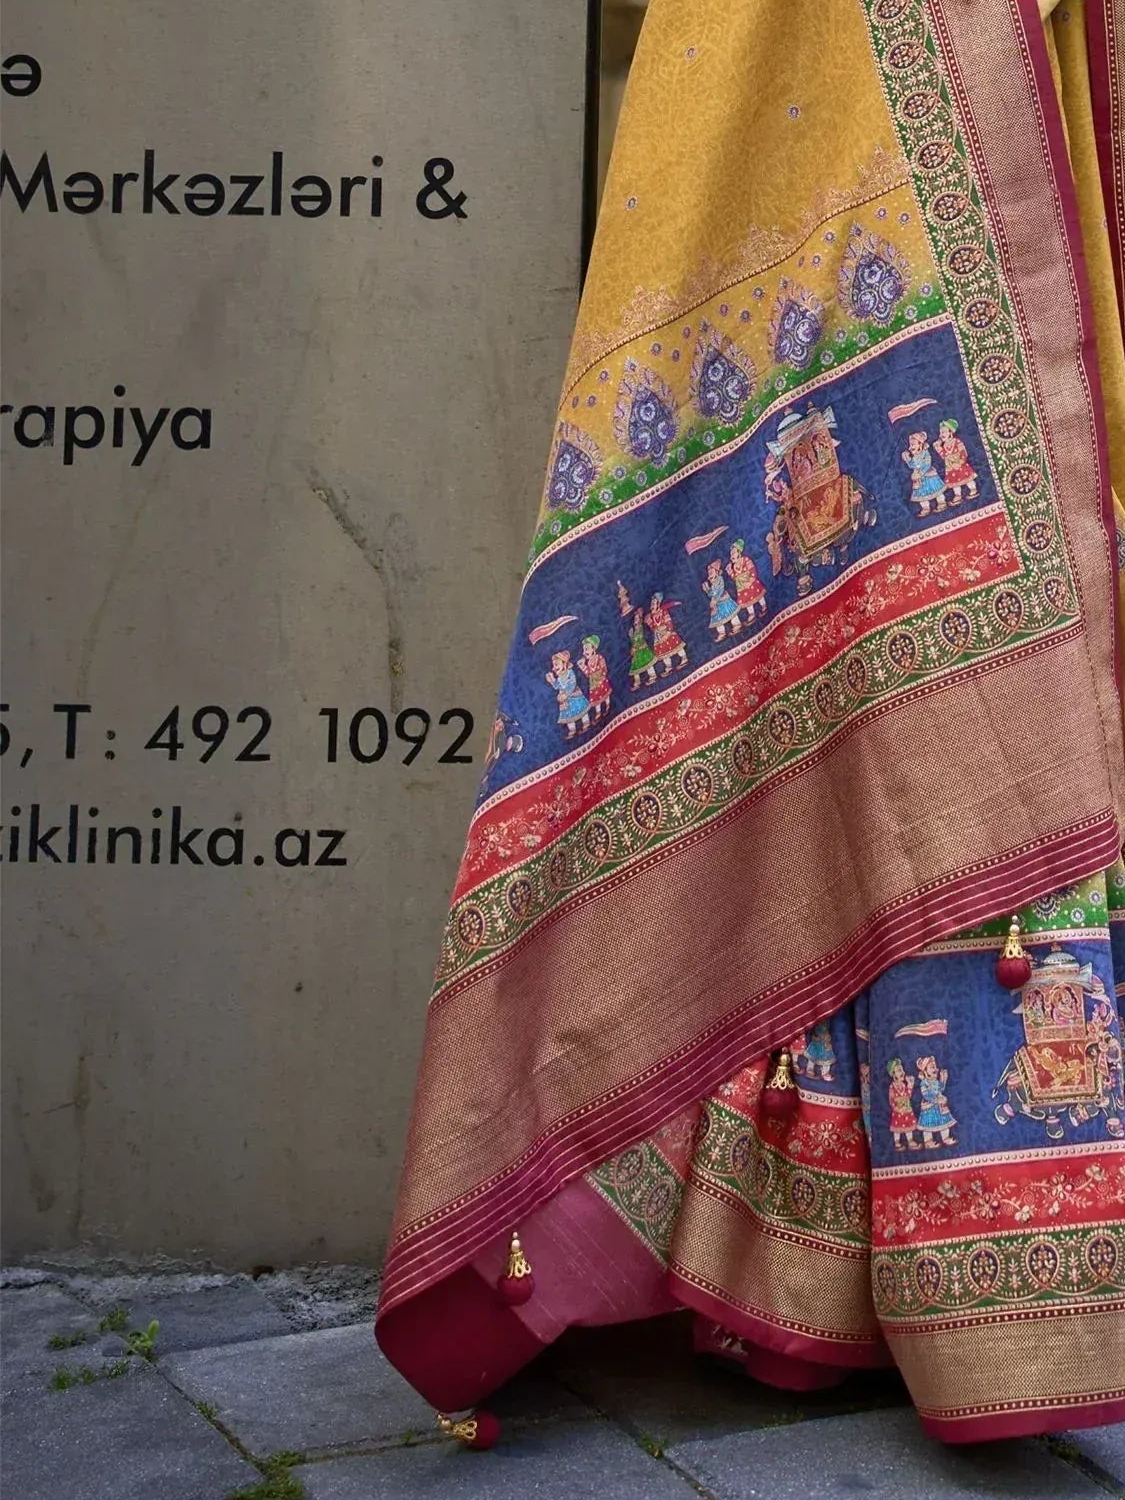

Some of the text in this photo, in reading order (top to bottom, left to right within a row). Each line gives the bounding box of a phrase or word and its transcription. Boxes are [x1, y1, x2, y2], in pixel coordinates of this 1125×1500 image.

[0, 149, 468, 220] Mərkəzləri &
[144, 704, 273, 764] 492
[319, 706, 475, 767] 1092
[0, 803, 348, 867] iklinika.az
